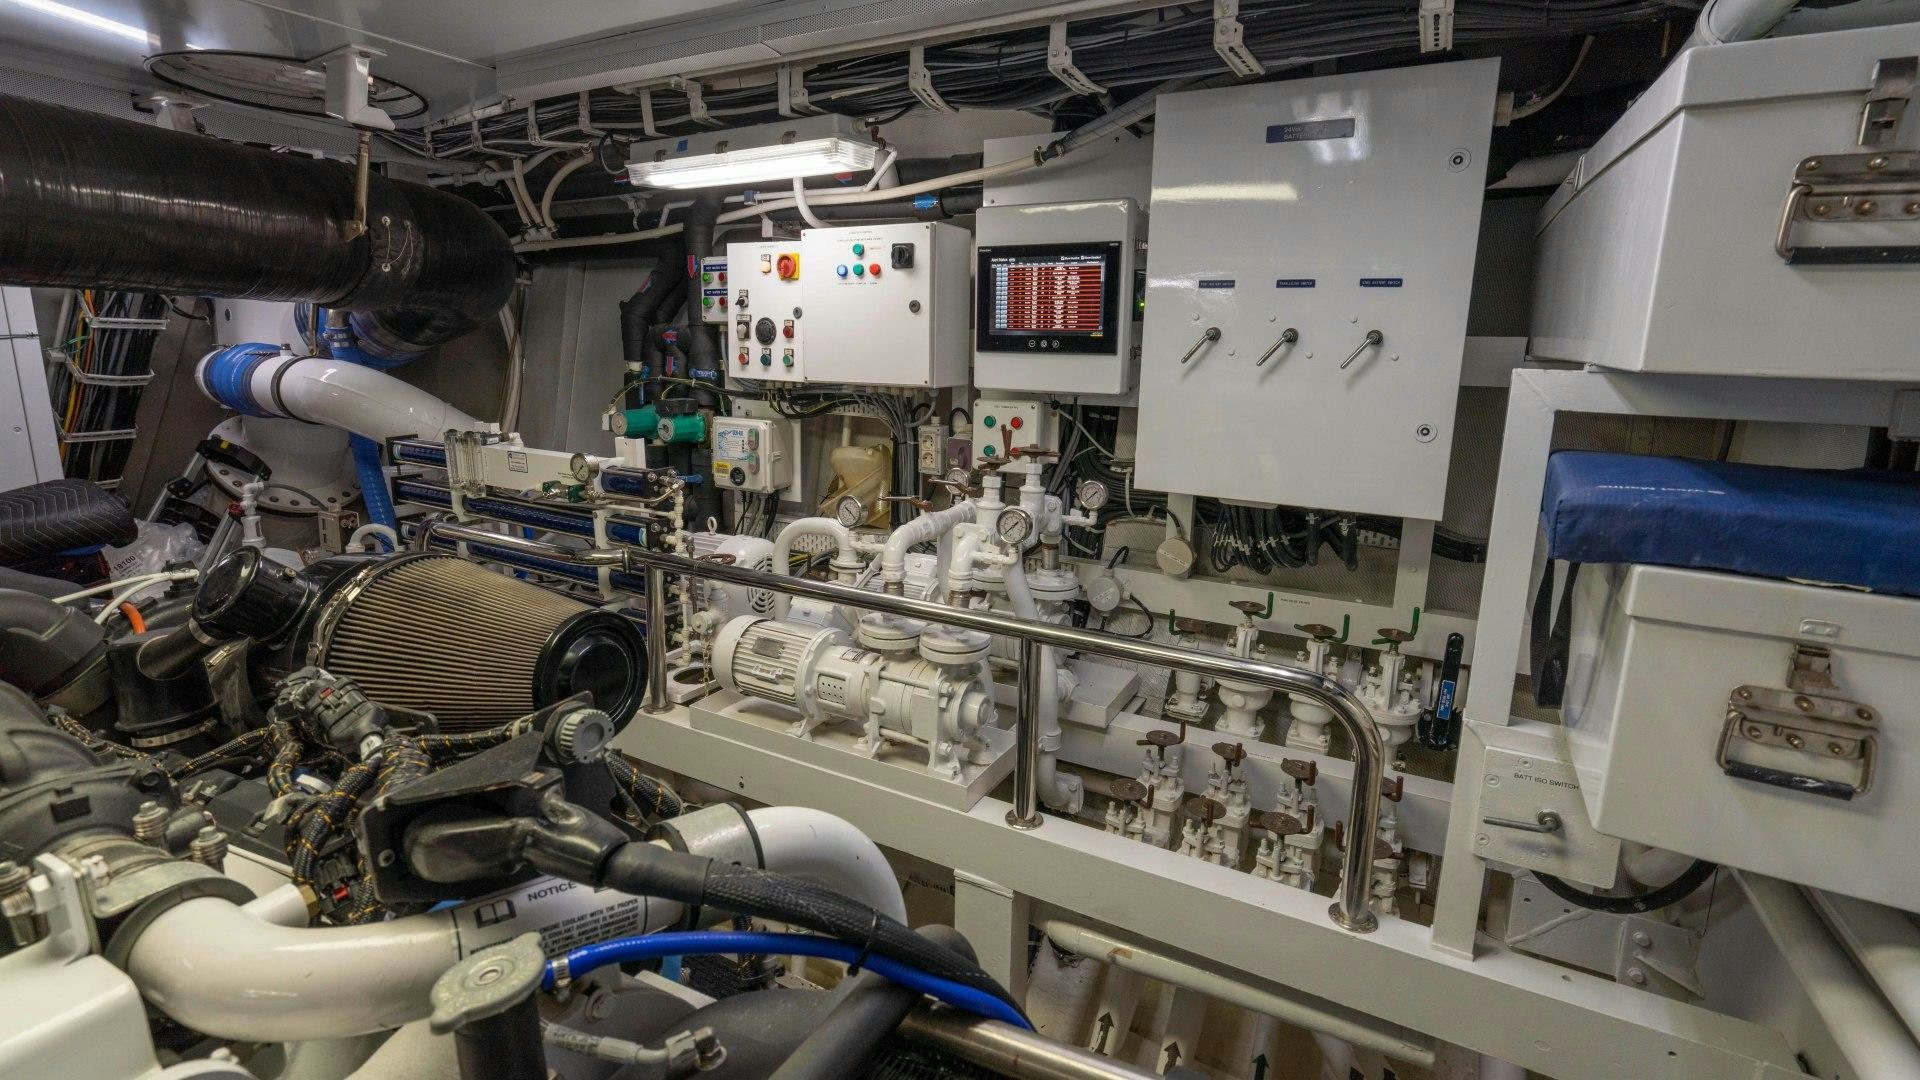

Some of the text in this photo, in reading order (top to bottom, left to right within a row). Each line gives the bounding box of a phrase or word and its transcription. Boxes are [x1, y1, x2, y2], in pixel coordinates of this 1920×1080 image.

[1513, 772, 1579, 790] BATT ISO SWITCH
[527, 881, 577, 902] NOTICE
[548, 925, 575, 939] COOLANT
[576, 917, 600, 931] ADDITIVE
[608, 905, 639, 919] NECESSARY
[561, 913, 588, 927] COOLANT
[589, 908, 604, 918] WITH
[605, 904, 616, 912] THE
[616, 898, 638, 910] PROPER
